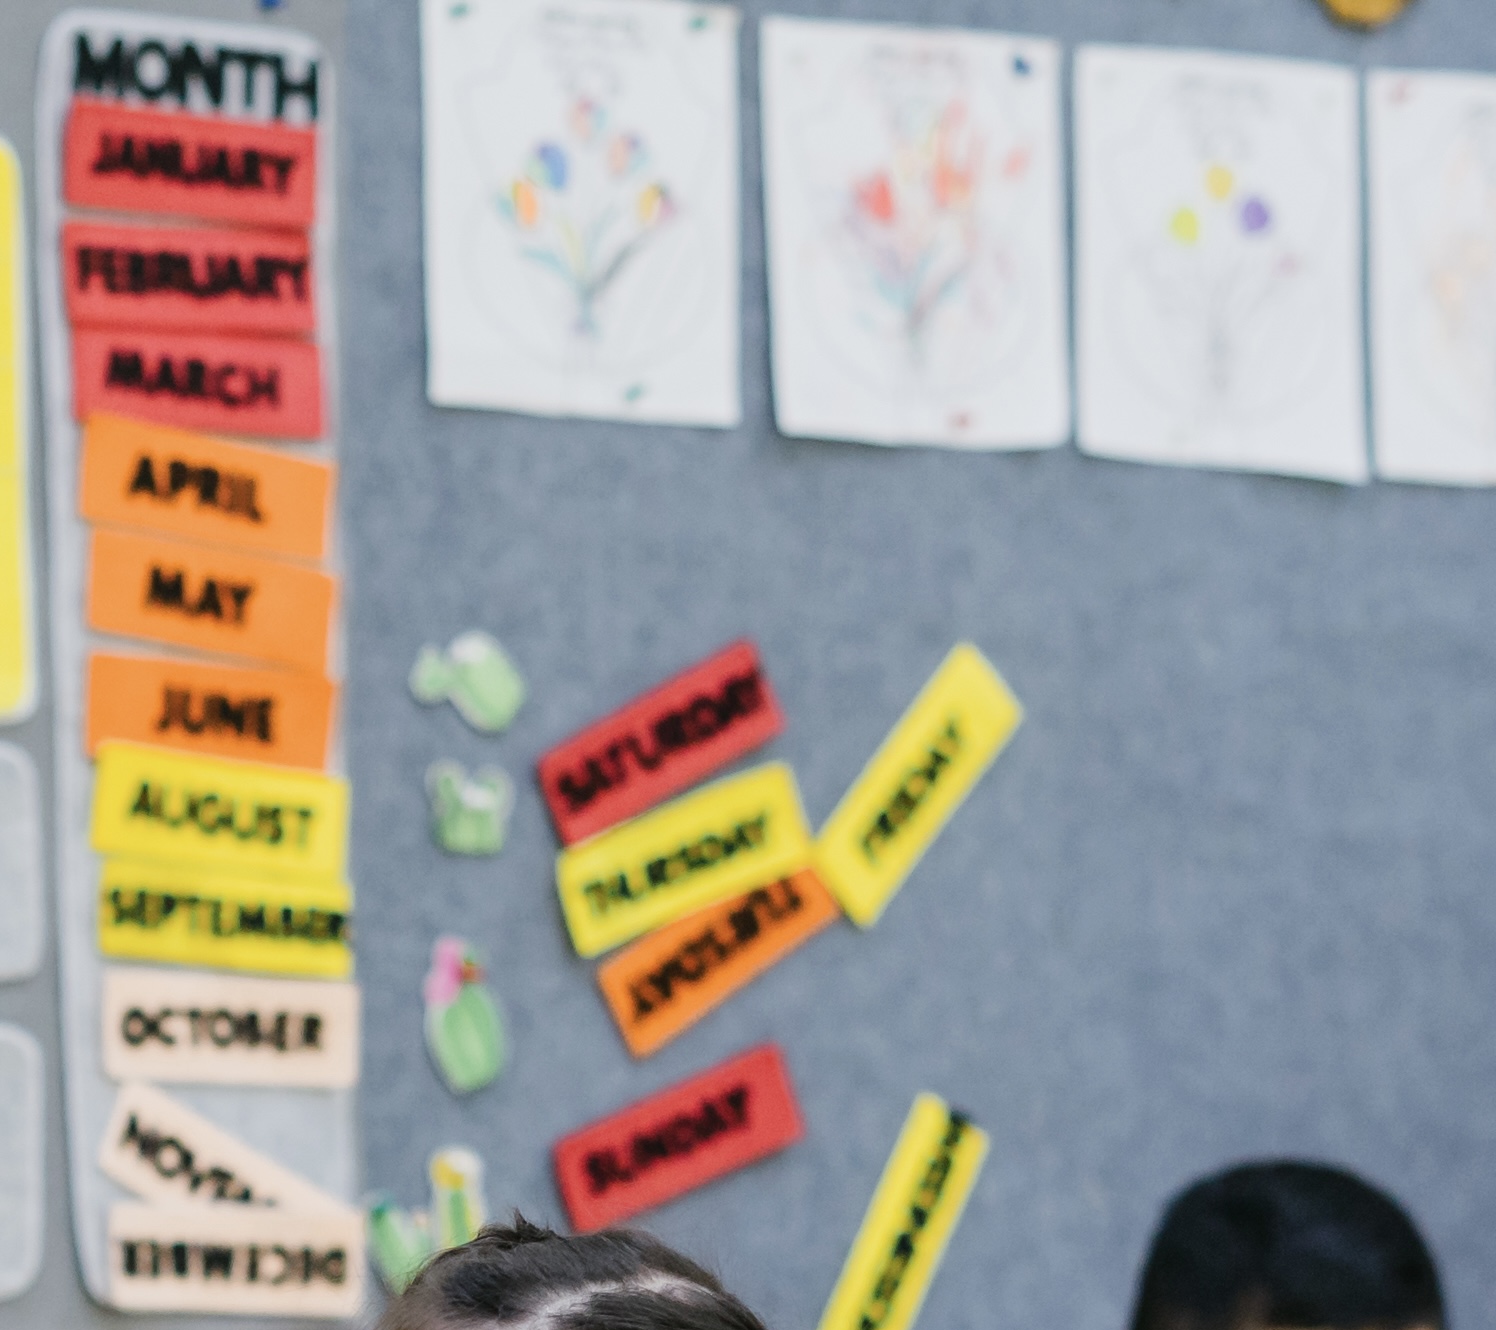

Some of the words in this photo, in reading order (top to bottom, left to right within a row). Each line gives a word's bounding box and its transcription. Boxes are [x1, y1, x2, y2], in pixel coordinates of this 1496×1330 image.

[73, 32, 320, 121] MONTH
[93, 132, 298, 195] JANUARY
[76, 245, 310, 303] FEBRUARY
[105, 349, 282, 412] MARCH
[126, 455, 264, 525] APRIL
[145, 563, 254, 635] MAY
[156, 682, 274, 745] JUNE
[558, 669, 764, 812] SATURDAY
[129, 780, 314, 845] AUGUST
[858, 716, 968, 870] FRIDAY
[583, 810, 768, 918] THURSDAY
[108, 888, 352, 944] SEPTEMBER
[626, 876, 804, 1022] TUESDAY
[121, 1006, 326, 1054] OCTOBER
[583, 1082, 753, 1196] SUNDAY
[120, 1238, 347, 1286] DECEMBER
